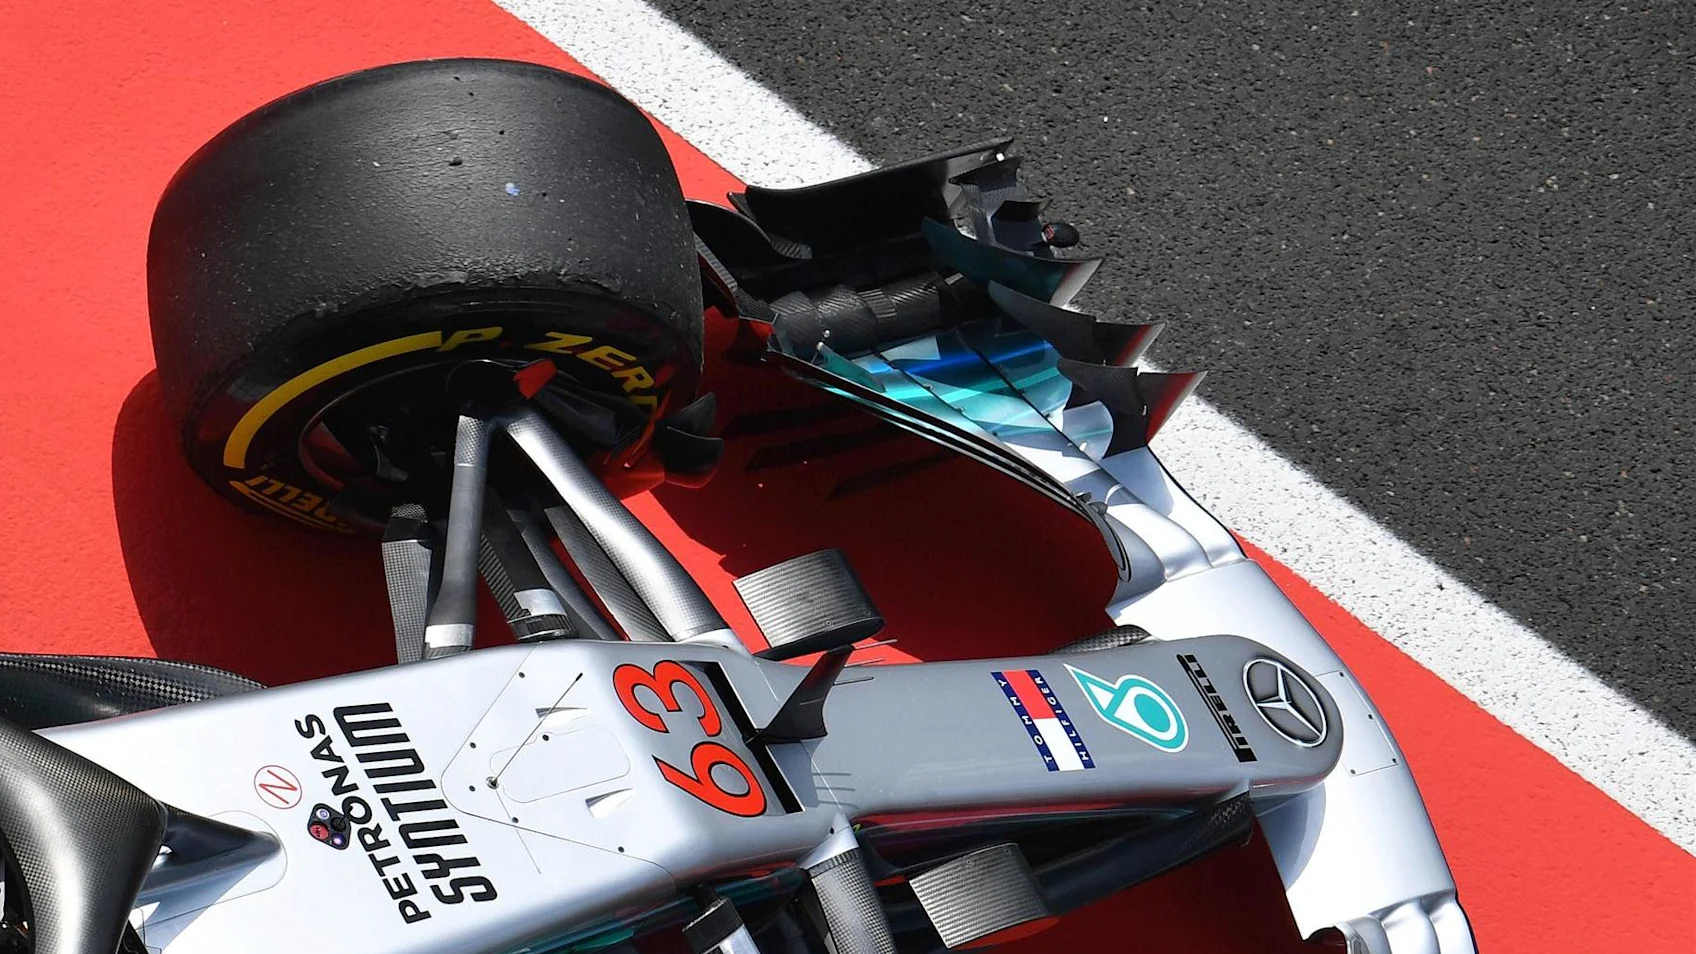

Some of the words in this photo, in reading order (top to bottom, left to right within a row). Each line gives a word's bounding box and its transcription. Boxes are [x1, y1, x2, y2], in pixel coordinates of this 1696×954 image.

[613, 659, 768, 818] 63
[998, 679, 1053, 763] TOMMY
[1034, 676, 1089, 761] HILFIGER
[1176, 654, 1258, 763] PIRELLI
[294, 714, 432, 925] PETRONAS
[333, 702, 498, 904] SYNTIUM
